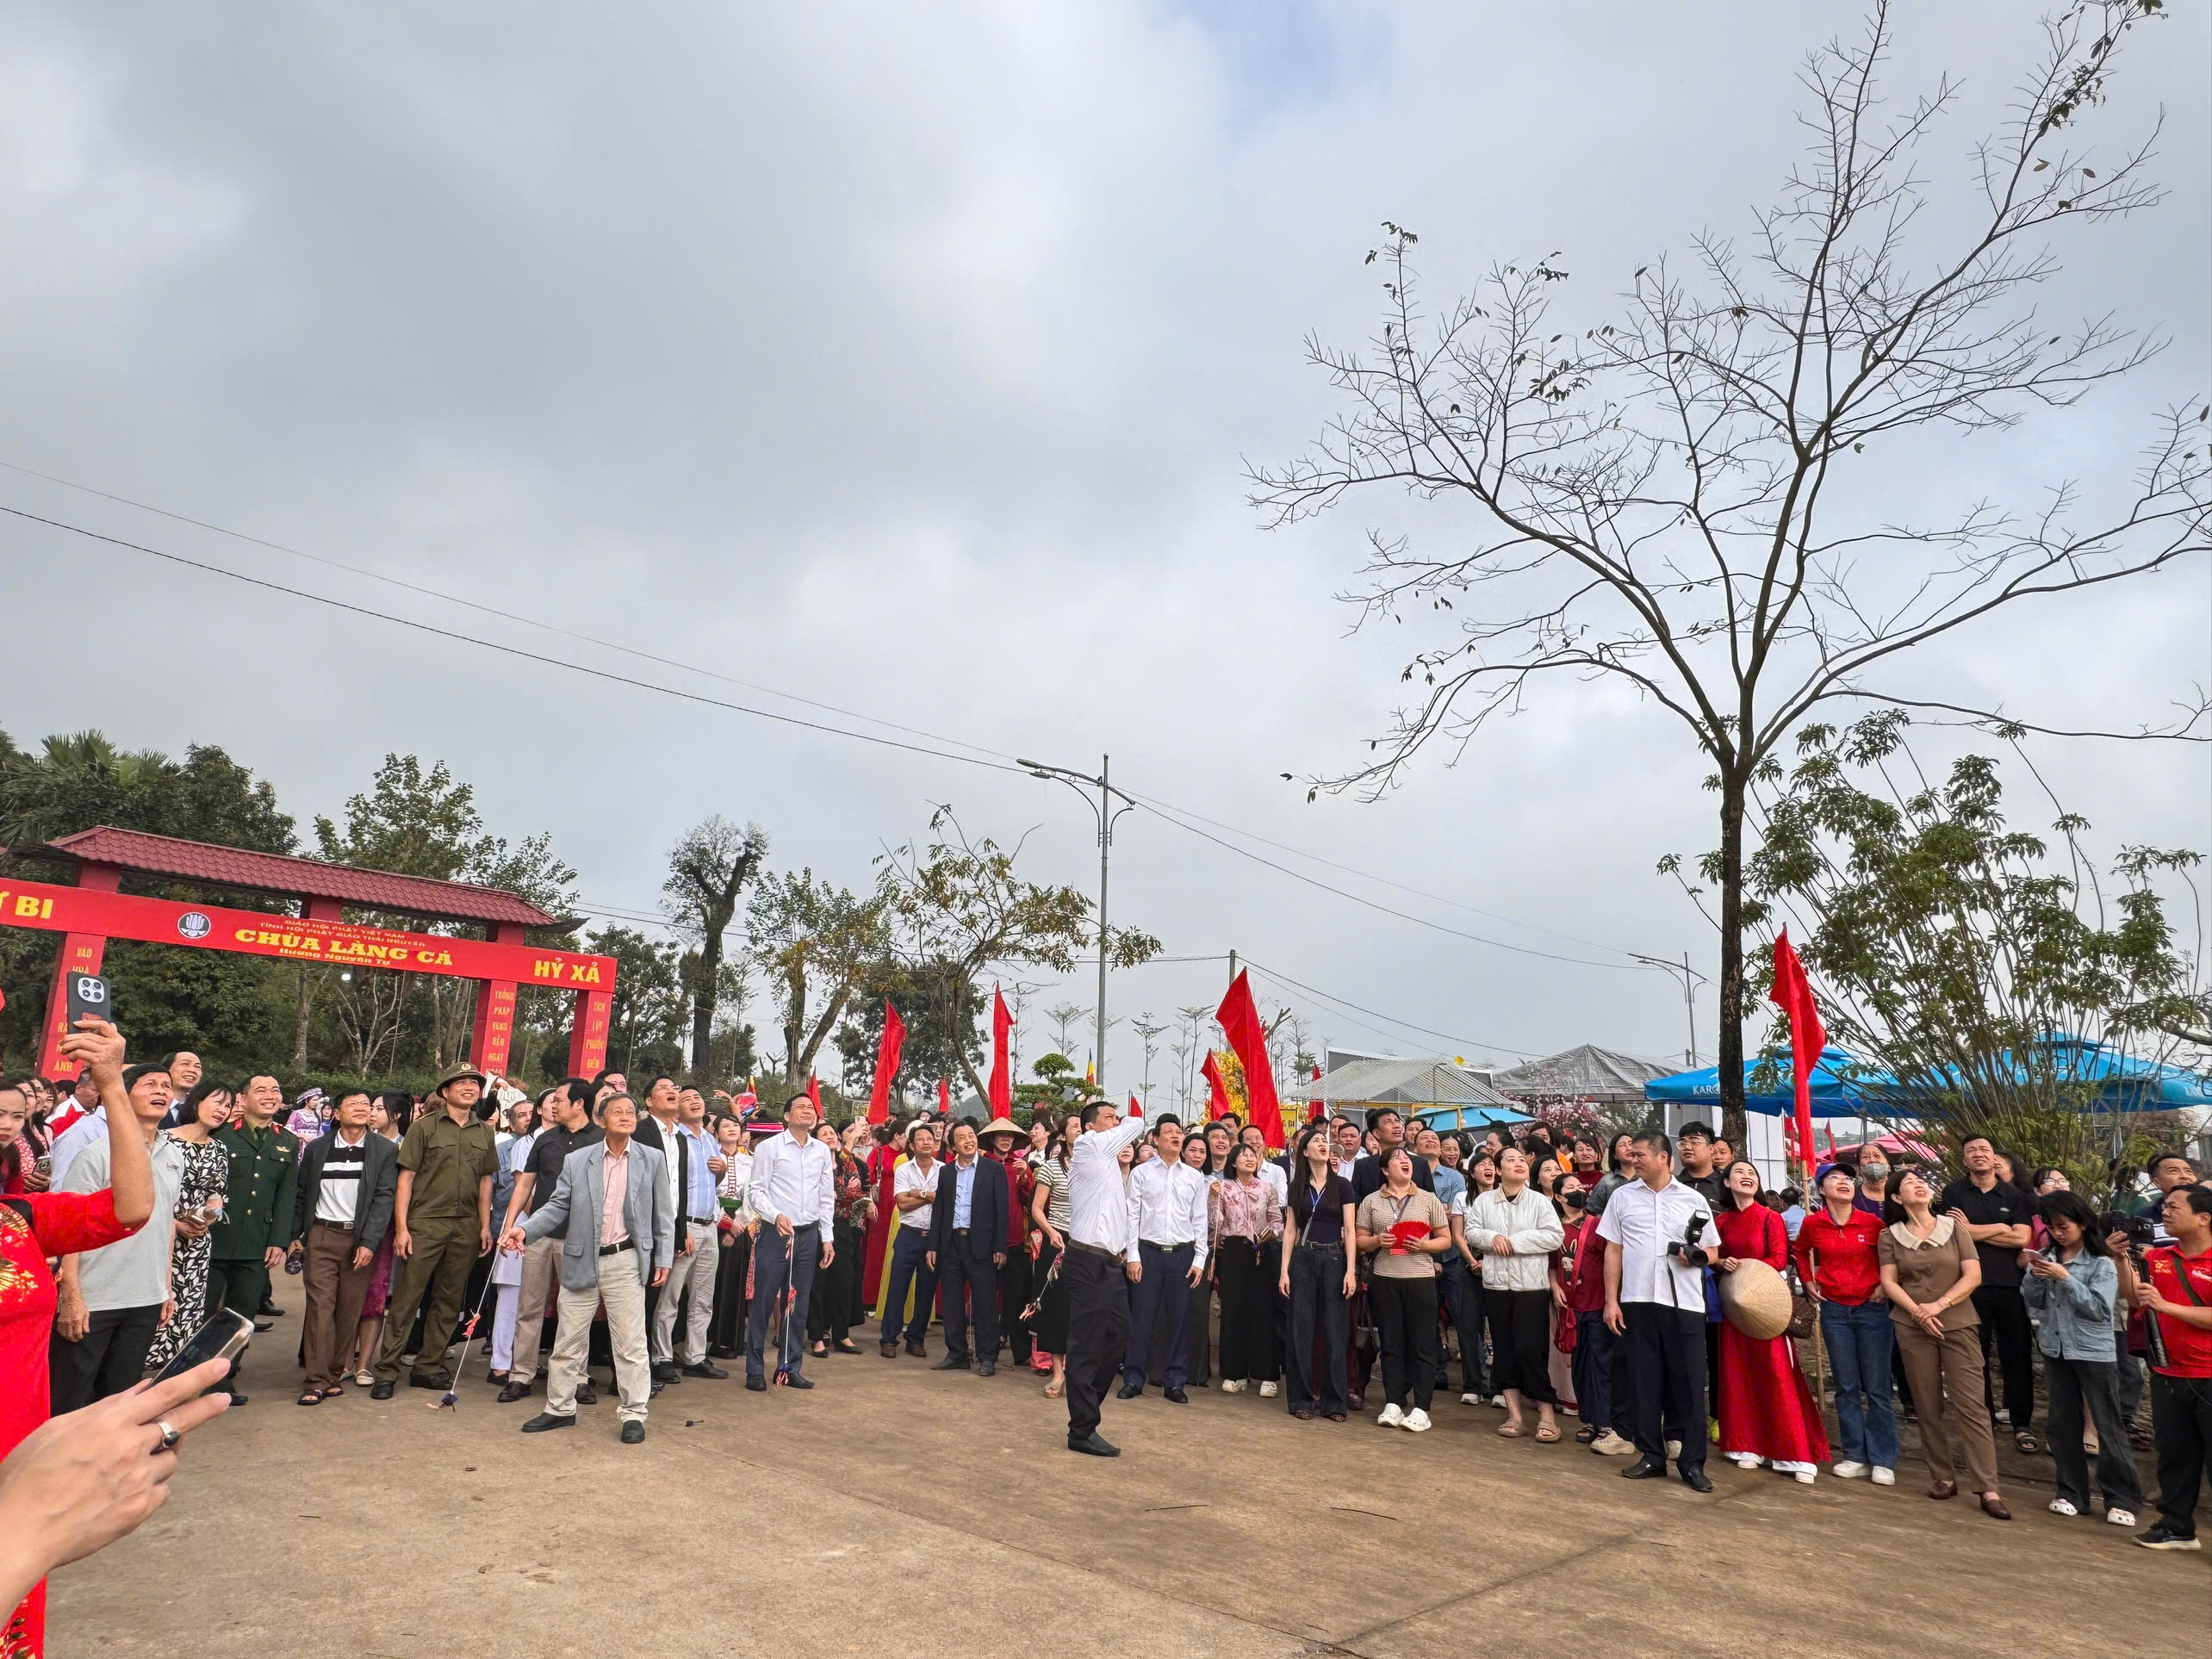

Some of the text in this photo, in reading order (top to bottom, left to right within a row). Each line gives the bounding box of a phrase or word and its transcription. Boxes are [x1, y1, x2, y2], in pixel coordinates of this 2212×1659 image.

[15, 895, 53, 919] BI
[234, 929, 321, 951] CHÙA
[329, 939, 407, 960] LÀNG
[534, 957, 600, 984] HỶ XẢ
